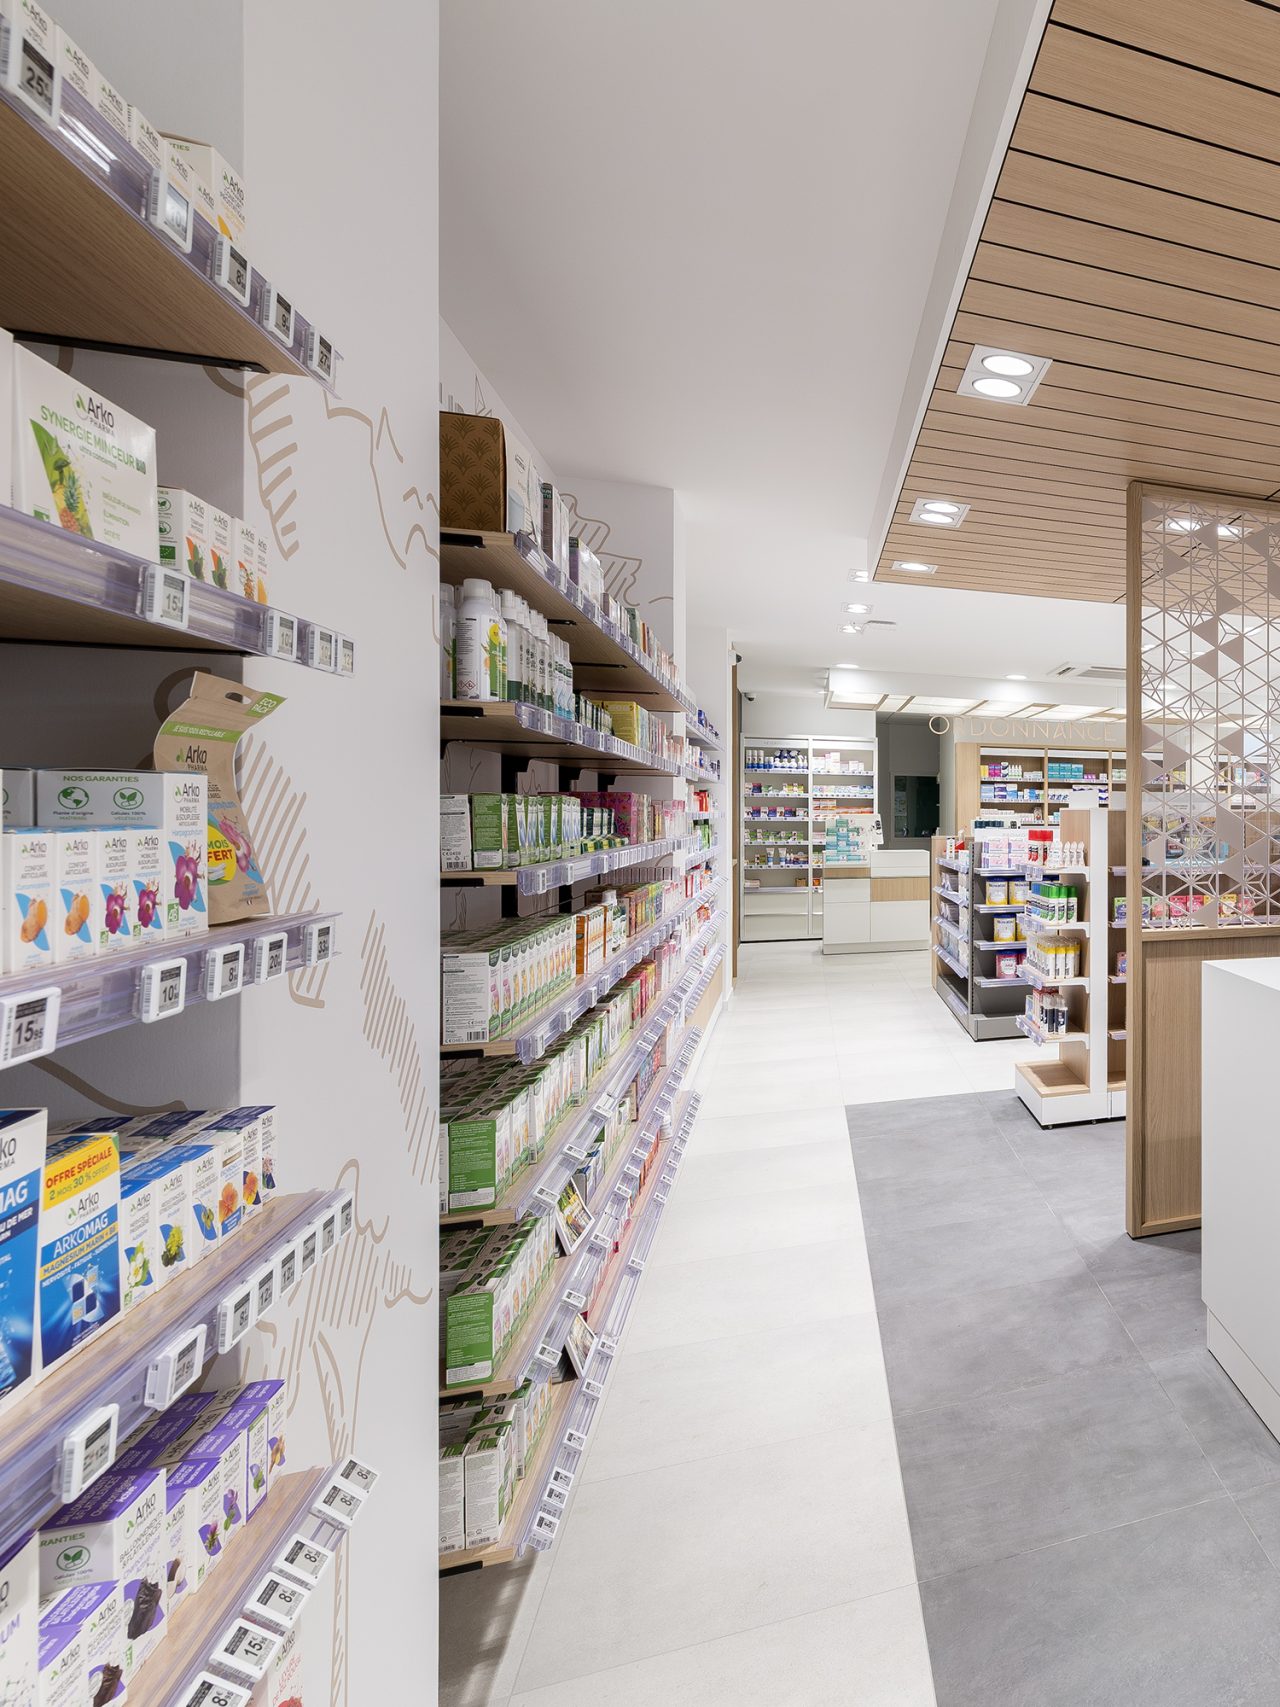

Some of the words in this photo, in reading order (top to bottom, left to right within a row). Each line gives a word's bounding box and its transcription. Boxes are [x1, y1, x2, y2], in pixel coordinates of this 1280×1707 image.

[88, 397, 114, 428] Arko
[40, 405, 94, 446] SYNERGIE
[94, 435, 135, 468] MINCEUR
[259, 697, 277, 708] ECO
[928, 713, 1117, 742] ORDONNANCE
[185, 745, 208, 764] Arko
[86, 775, 139, 783] GARANTIES
[182, 783, 200, 798] Arko
[29, 840, 48, 853] Arko
[73, 840, 89, 852] Arko
[112, 838, 127, 849] Arko
[143, 835, 160, 848] Arko
[207, 839, 229, 850] MOIS
[45, 1164, 76, 1189] OFFRE
[77, 1146, 112, 1175] SPÉCIALE
[73, 1175, 84, 1190] 30
[78, 1191, 100, 1212] Arko
[53, 1213, 109, 1259] ARKOMAG
[135, 1493, 157, 1520] Arko
